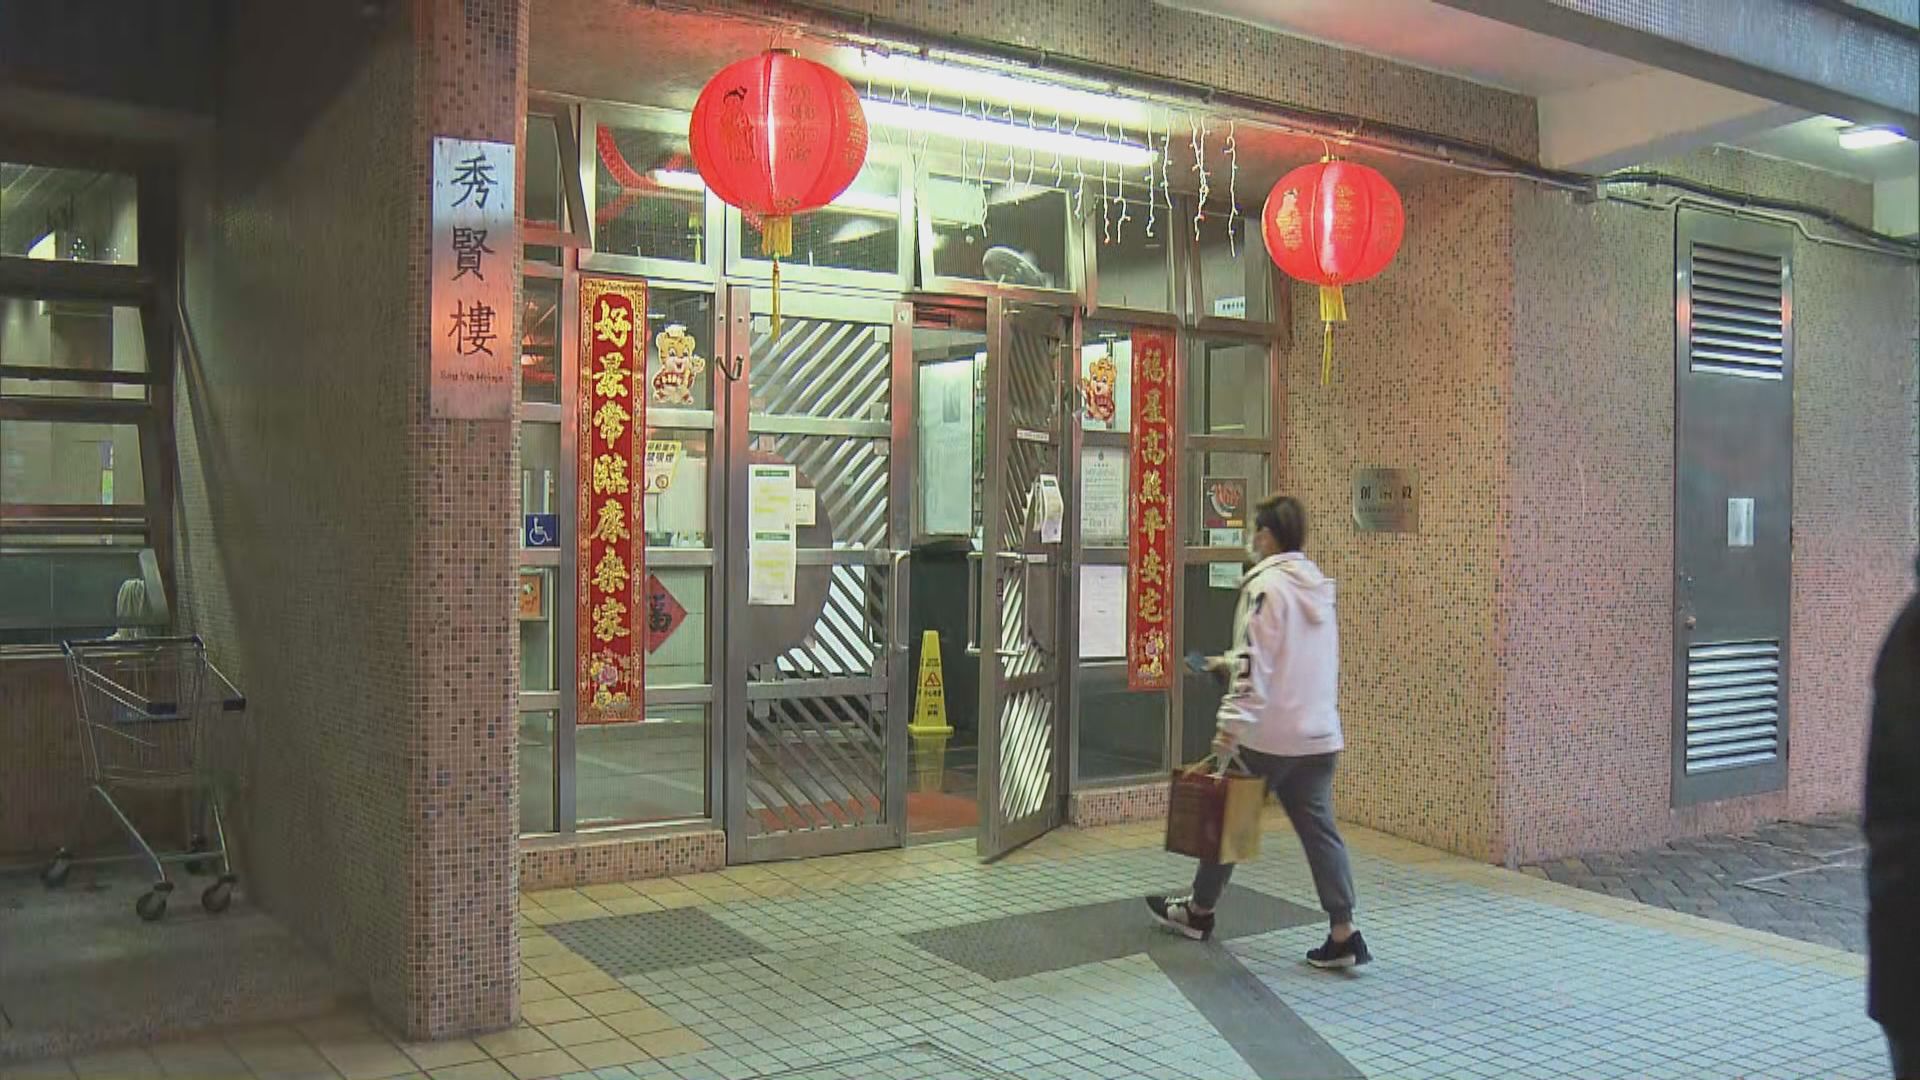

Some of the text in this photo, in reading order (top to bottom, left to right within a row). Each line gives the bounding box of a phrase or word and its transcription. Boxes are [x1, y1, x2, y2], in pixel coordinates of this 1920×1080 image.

[447, 155, 498, 356] 秀賢樓
[591, 300, 632, 643] 好景常臨康樂家
